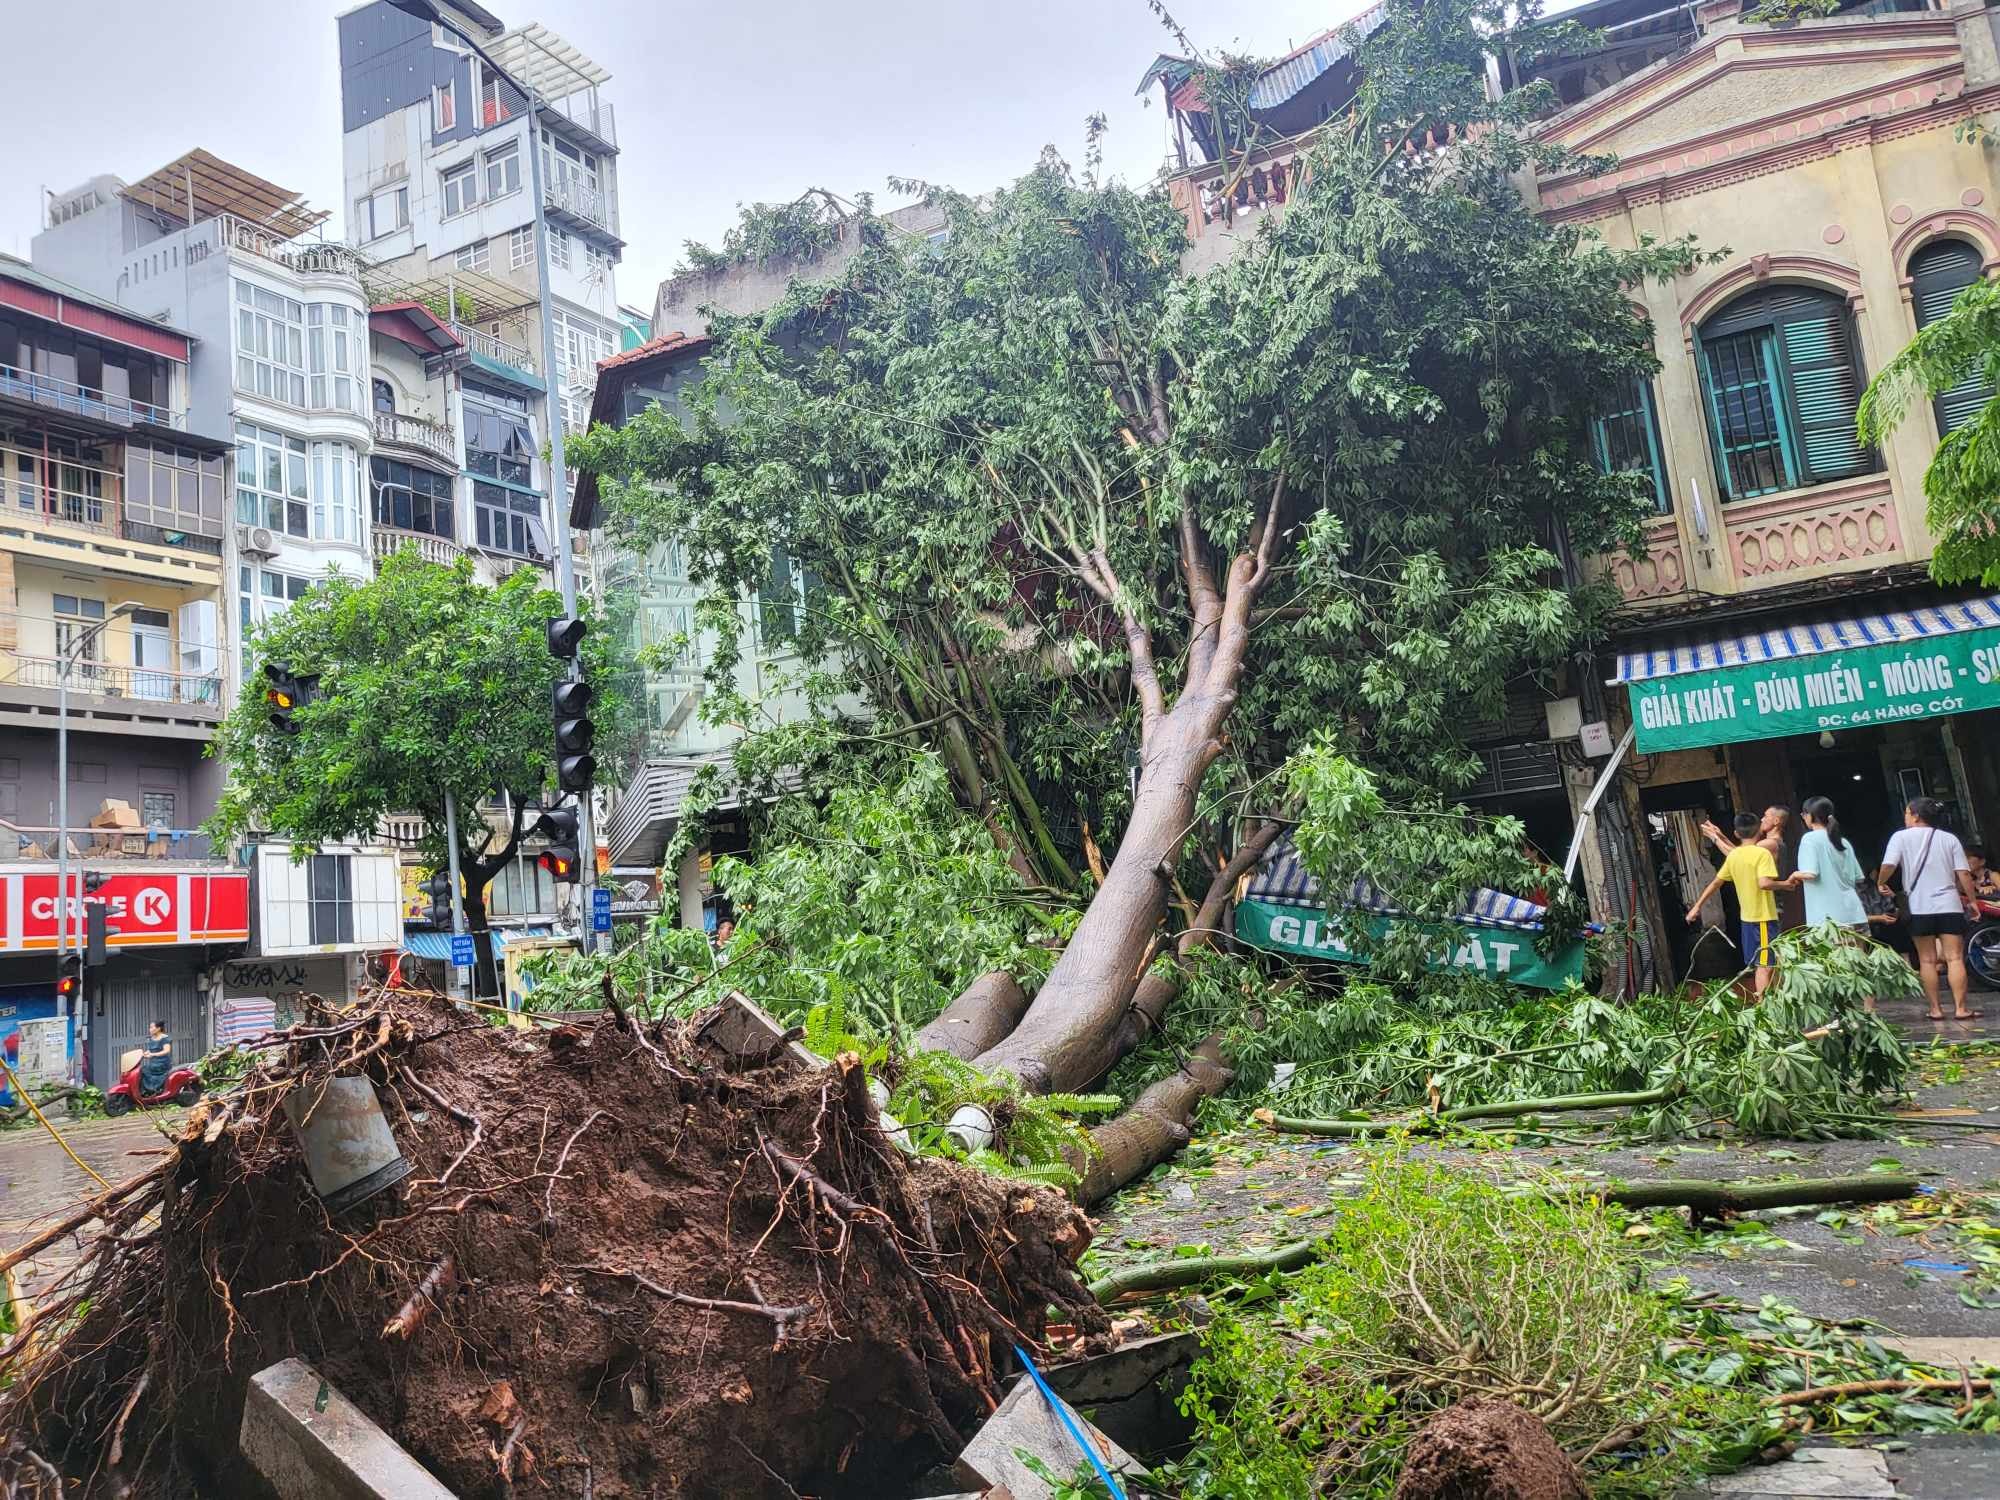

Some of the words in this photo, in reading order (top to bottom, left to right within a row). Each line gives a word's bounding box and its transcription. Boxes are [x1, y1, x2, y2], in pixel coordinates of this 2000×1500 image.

[1640, 683, 1681, 729] GIẢI
[1684, 680, 1736, 724] KHÁT
[1754, 672, 1801, 714] BÚN
[1804, 659, 1864, 707] MIẾN
[1881, 652, 1954, 697] MÓNG
[1851, 711, 1871, 723] 64
[1875, 703, 1924, 720] HÀNG
[1928, 696, 1963, 713] CÓT
[141, 891, 170, 924] K
